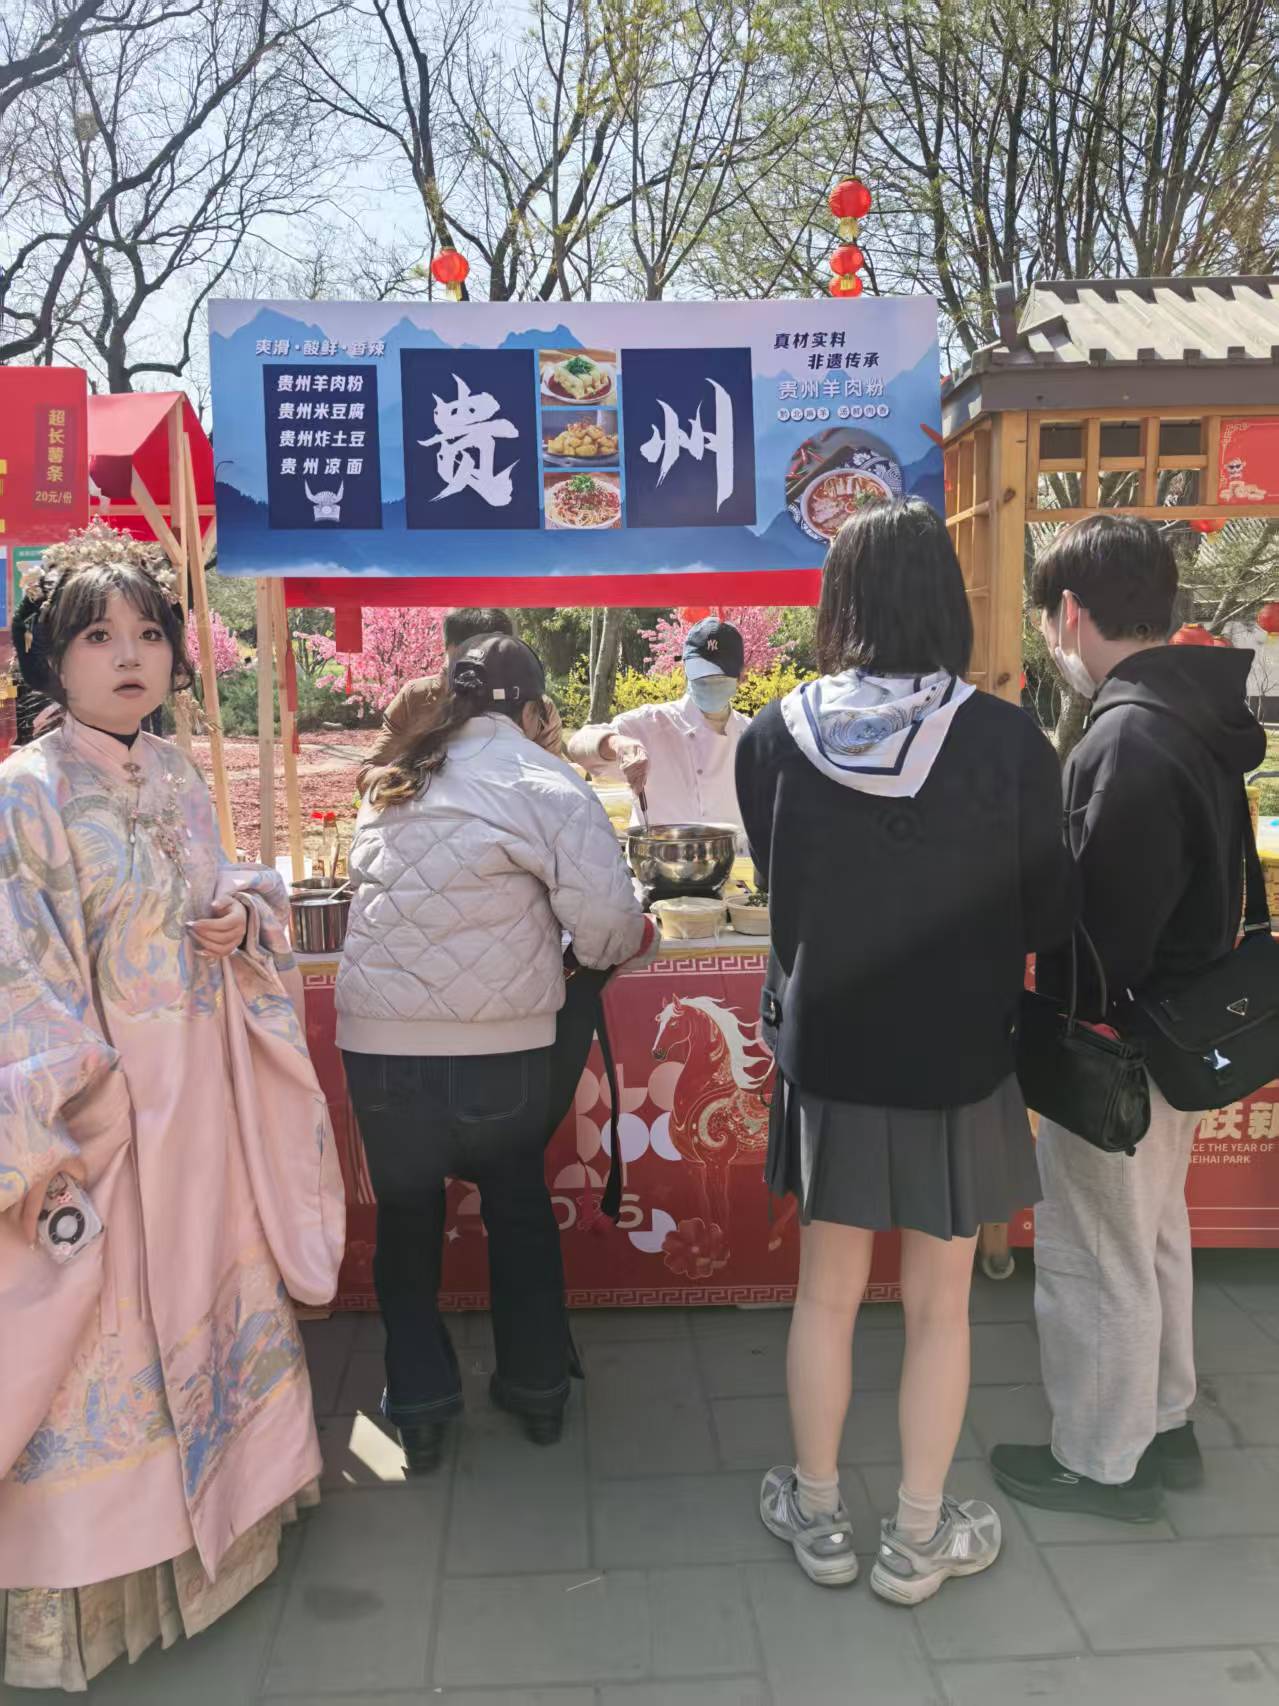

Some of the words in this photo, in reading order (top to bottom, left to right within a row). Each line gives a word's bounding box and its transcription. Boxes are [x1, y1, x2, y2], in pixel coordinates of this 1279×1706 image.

[774, 331, 846, 349] 真材实料
[808, 352, 880, 369] 非遗传承
[277, 374, 364, 393] 贵州羊肉粉
[778, 378, 885, 400] 贵州羊肉粉
[278, 402, 365, 420] 贵州米豆腐
[279, 430, 366, 447] 贵州炸土豆
[417, 373, 520, 507] 贵
[640, 377, 734, 513] 州
[280, 458, 364, 475] 贵州凉面
[1192, 1143, 1206, 1152] CE
[1208, 1143, 1229, 1152] THE
[1231, 1143, 1258, 1152] YEAR
[1260, 1143, 1273, 1152] OF
[1190, 1155, 1221, 1164] EIHAI
[1223, 1155, 1251, 1164] PARK
